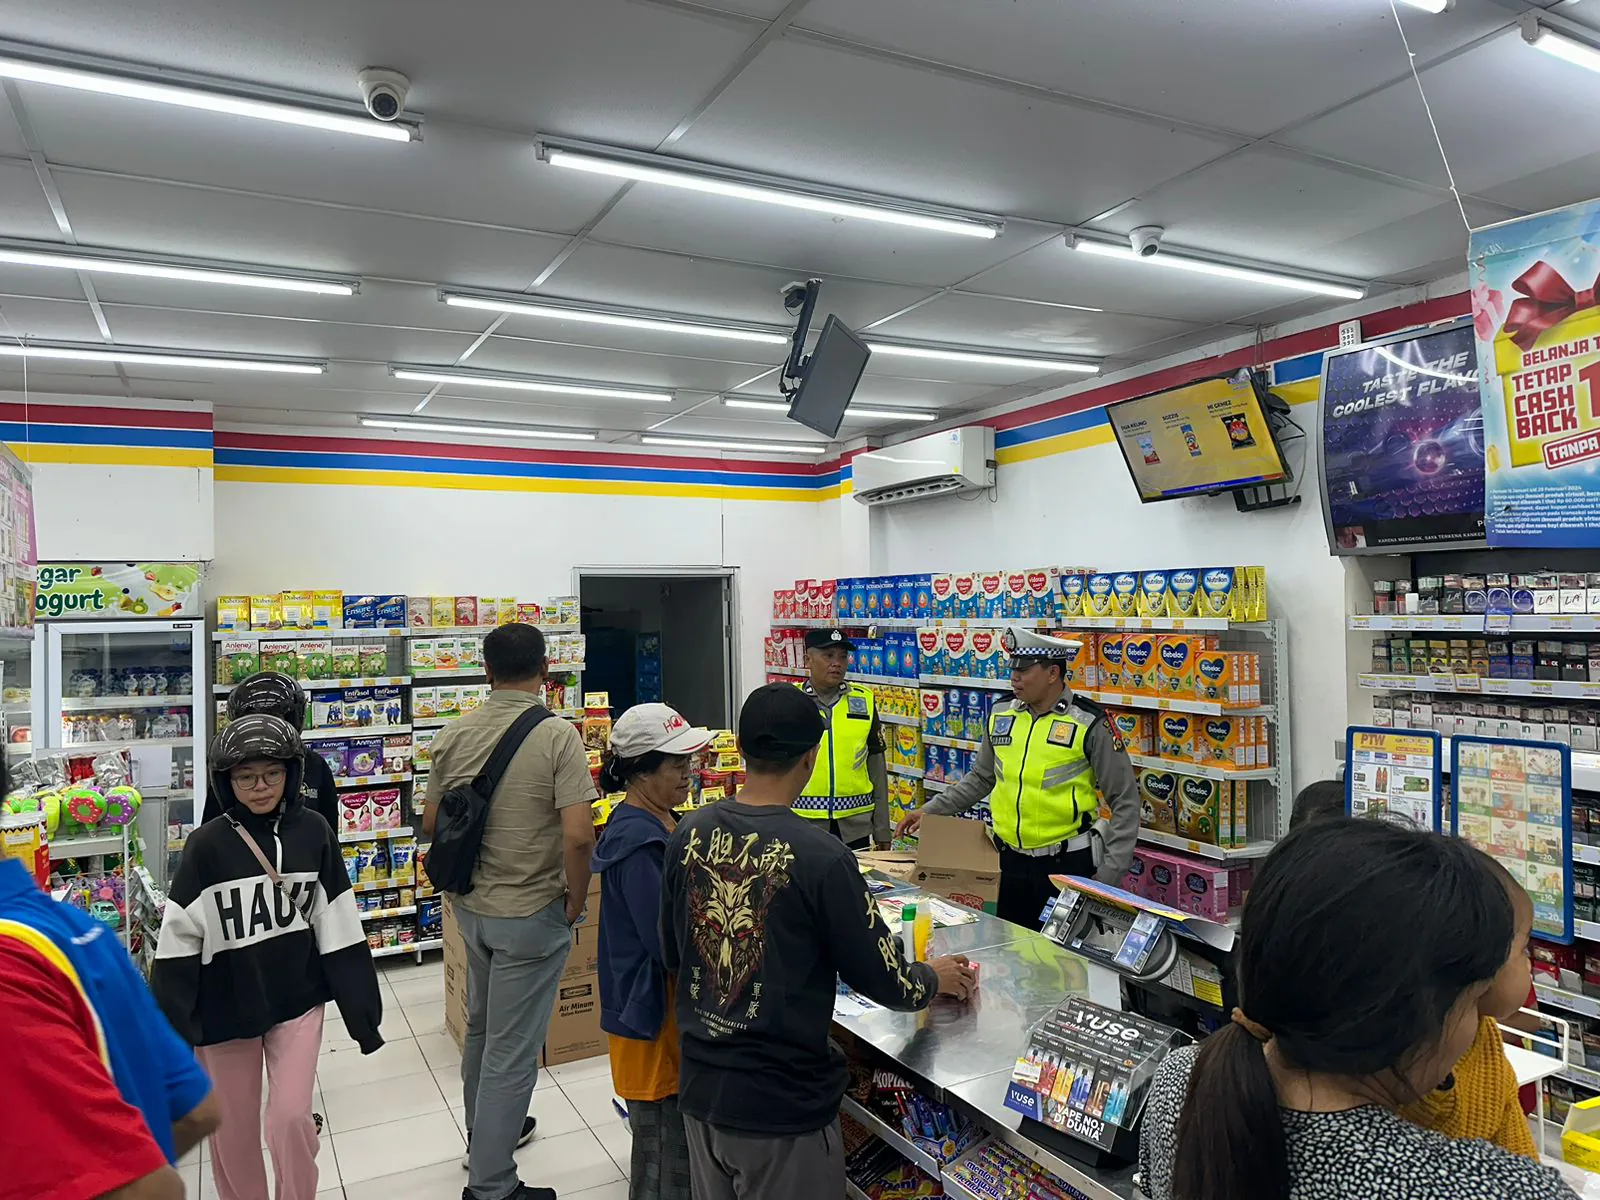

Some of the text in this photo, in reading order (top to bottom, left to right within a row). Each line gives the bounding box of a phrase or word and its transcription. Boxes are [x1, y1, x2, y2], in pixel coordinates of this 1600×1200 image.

[1523, 339, 1589, 367] BELANJA
[1363, 351, 1469, 393] TASTE THE
[1512, 363, 1572, 392] TETAP
[1333, 387, 1412, 418] COOLEST
[1514, 385, 1575, 417] CASH
[1516, 407, 1578, 439] BACK
[1549, 436, 1599, 461] TANPA
[346, 605, 371, 616] Ensure
[376, 604, 401, 615] Ensure
[1127, 647, 1147, 657] Bebelac
[1163, 649, 1184, 659] Bebelac
[1201, 664, 1221, 673] Bebelac
[1147, 672, 1154, 683] 4
[1185, 676, 1192, 687] 4
[1147, 779, 1171, 792] Bebelac
[1186, 784, 1208, 796] Bebelac
[558, 1001, 594, 1013] Air Minum
[1096, 1033, 1130, 1047] BEYOND
[1053, 1114, 1066, 1126] DI
[1056, 1103, 1105, 1132] VAPE NO.1
[967, 1160, 995, 1184] mentos
